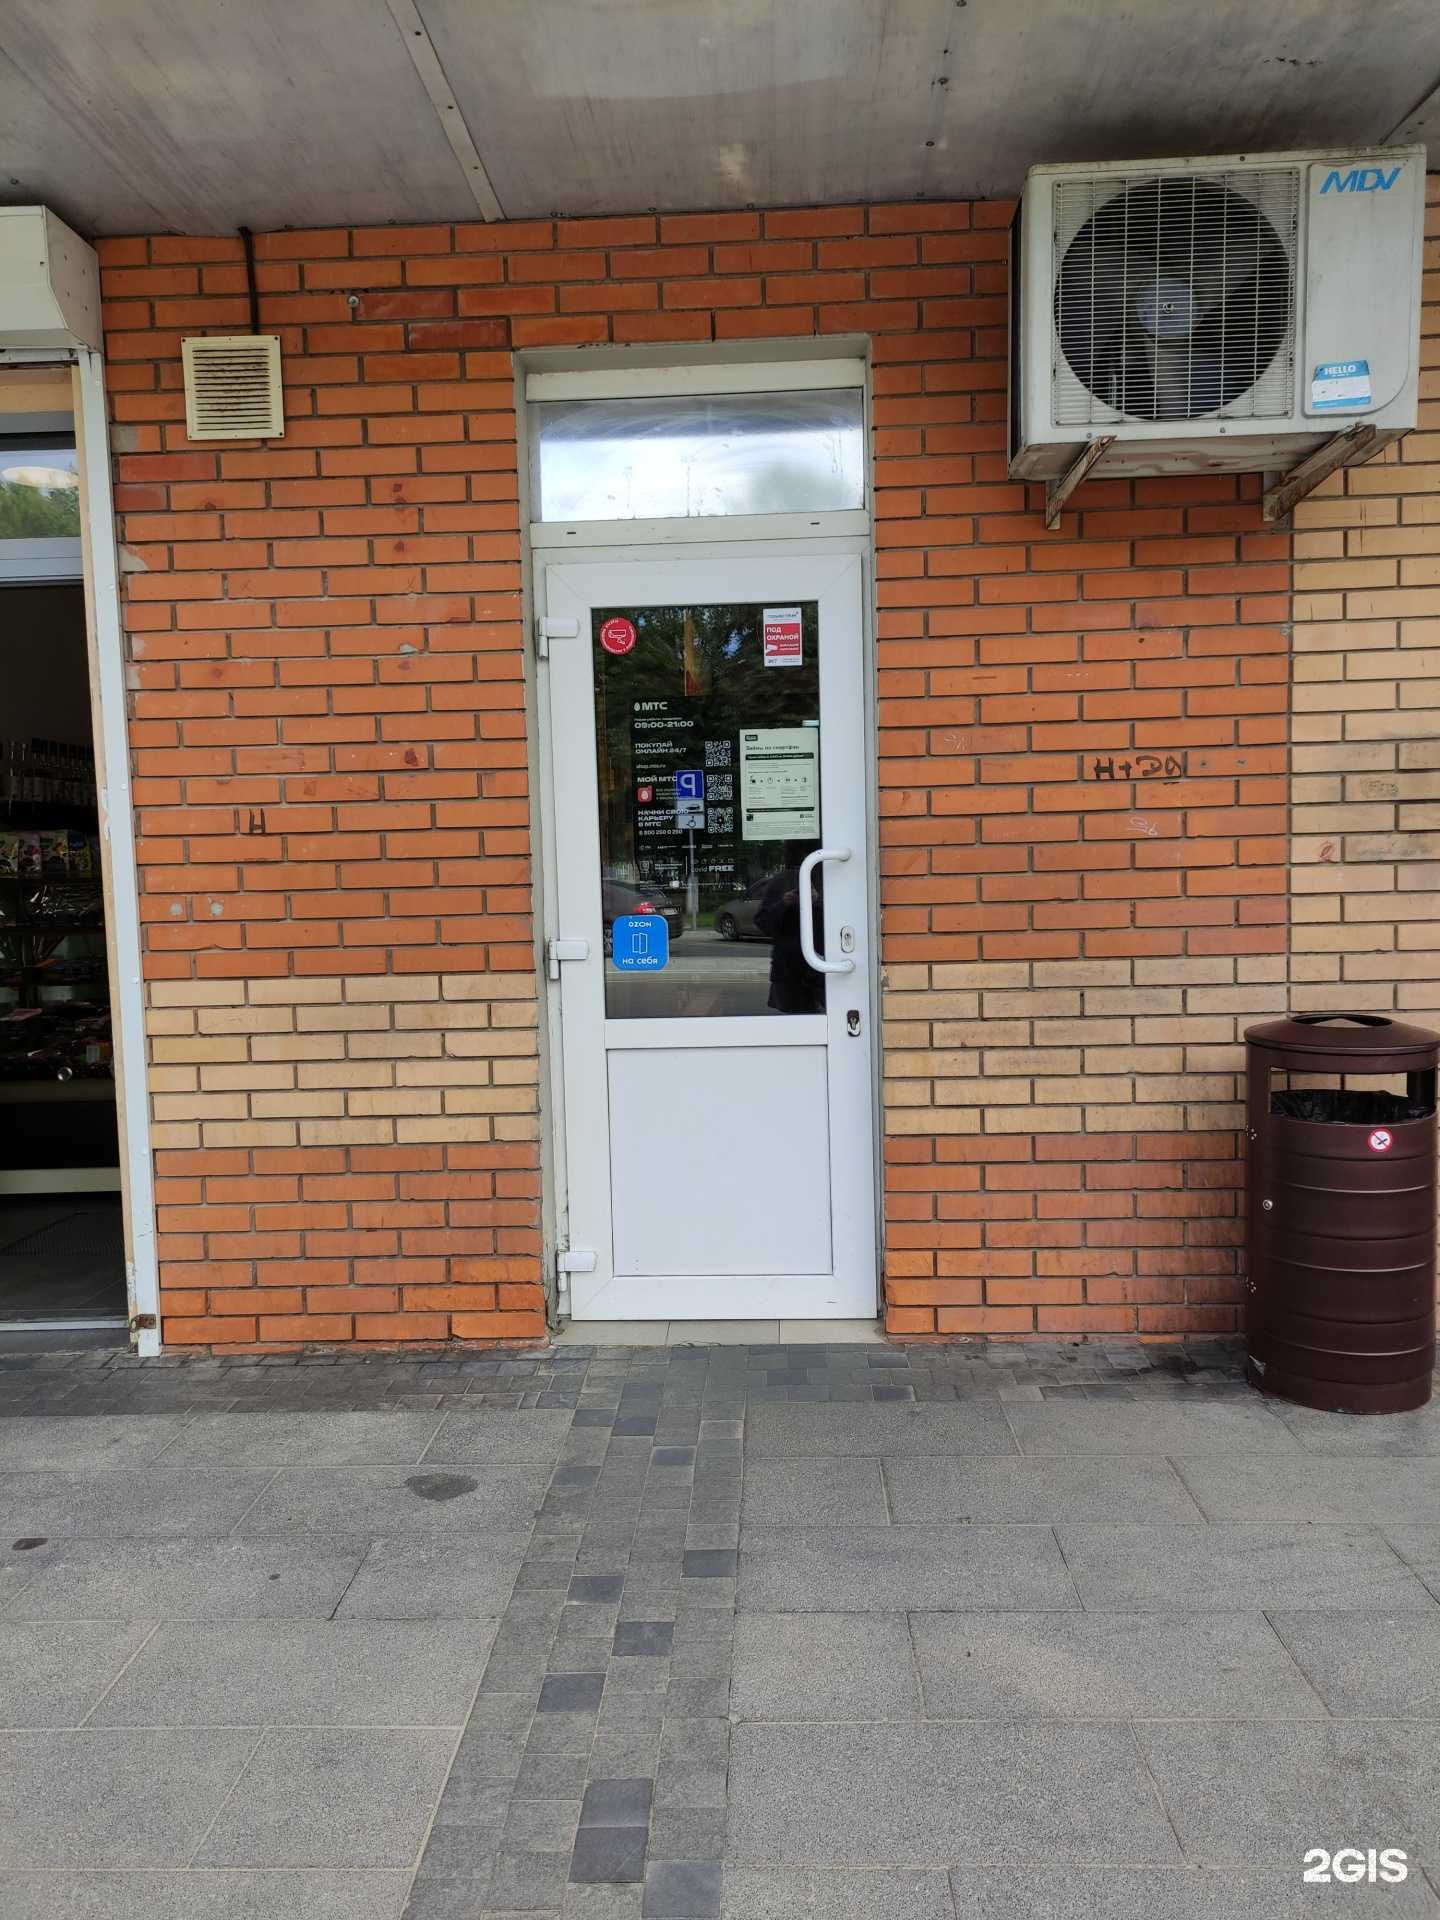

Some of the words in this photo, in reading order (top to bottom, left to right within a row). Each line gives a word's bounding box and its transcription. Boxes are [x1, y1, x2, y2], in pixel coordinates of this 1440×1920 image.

[1320, 167, 1402, 194] MDV
[1324, 365, 1356, 375] HELLO
[766, 632, 799, 641] ОХРАНОЙ
[641, 702, 668, 711] МТС
[635, 740, 673, 749] ПОКУПАЙ
[637, 775, 658, 783] МОЙ
[708, 864, 735, 872] FREE
[636, 956, 658, 964] себя
